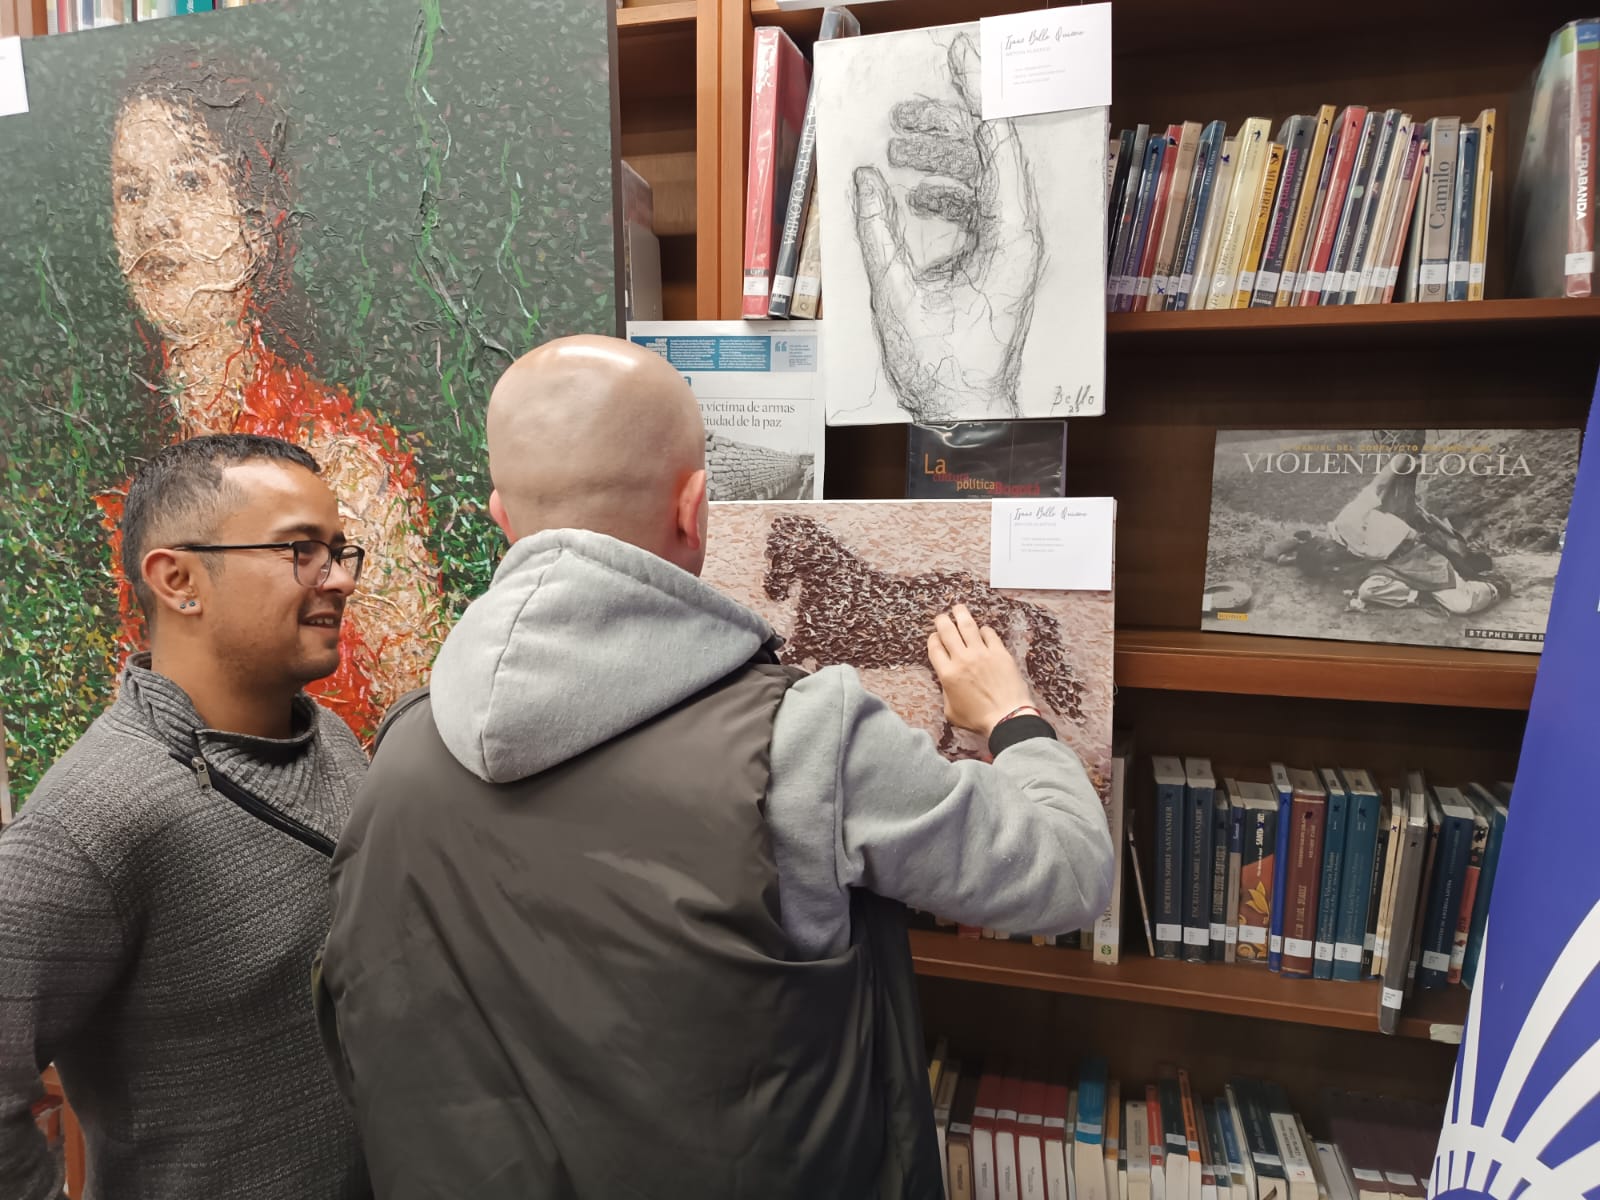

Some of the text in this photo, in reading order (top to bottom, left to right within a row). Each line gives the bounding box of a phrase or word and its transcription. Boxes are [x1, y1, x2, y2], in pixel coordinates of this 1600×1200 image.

[797, 158, 811, 176] EN
[1280, 148, 1299, 209] guardadas
[1575, 143, 1591, 220] OTRABANDA
[783, 178, 807, 245] COLOMBIA
[1259, 170, 1277, 218] MUJERES
[1428, 161, 1450, 229] Camilo
[706, 401, 745, 413] víctima
[747, 400, 760, 413] de
[761, 403, 796, 414] armas
[1050, 384, 1095, 409] Bello
[737, 415, 750, 427] de
[751, 415, 761, 427] la
[762, 417, 782, 430] paz
[924, 452, 947, 475] La
[1242, 448, 1535, 478] VIOLENTOLOGÍA
[956, 478, 995, 492] política
[1469, 630, 1514, 639] STEPHEN
[1165, 806, 1173, 852] SANTANDER
[1194, 808, 1203, 856] SANTANDER
[1163, 878, 1171, 914] ESCRITOS
[1192, 881, 1200, 918] ESCRITOS
